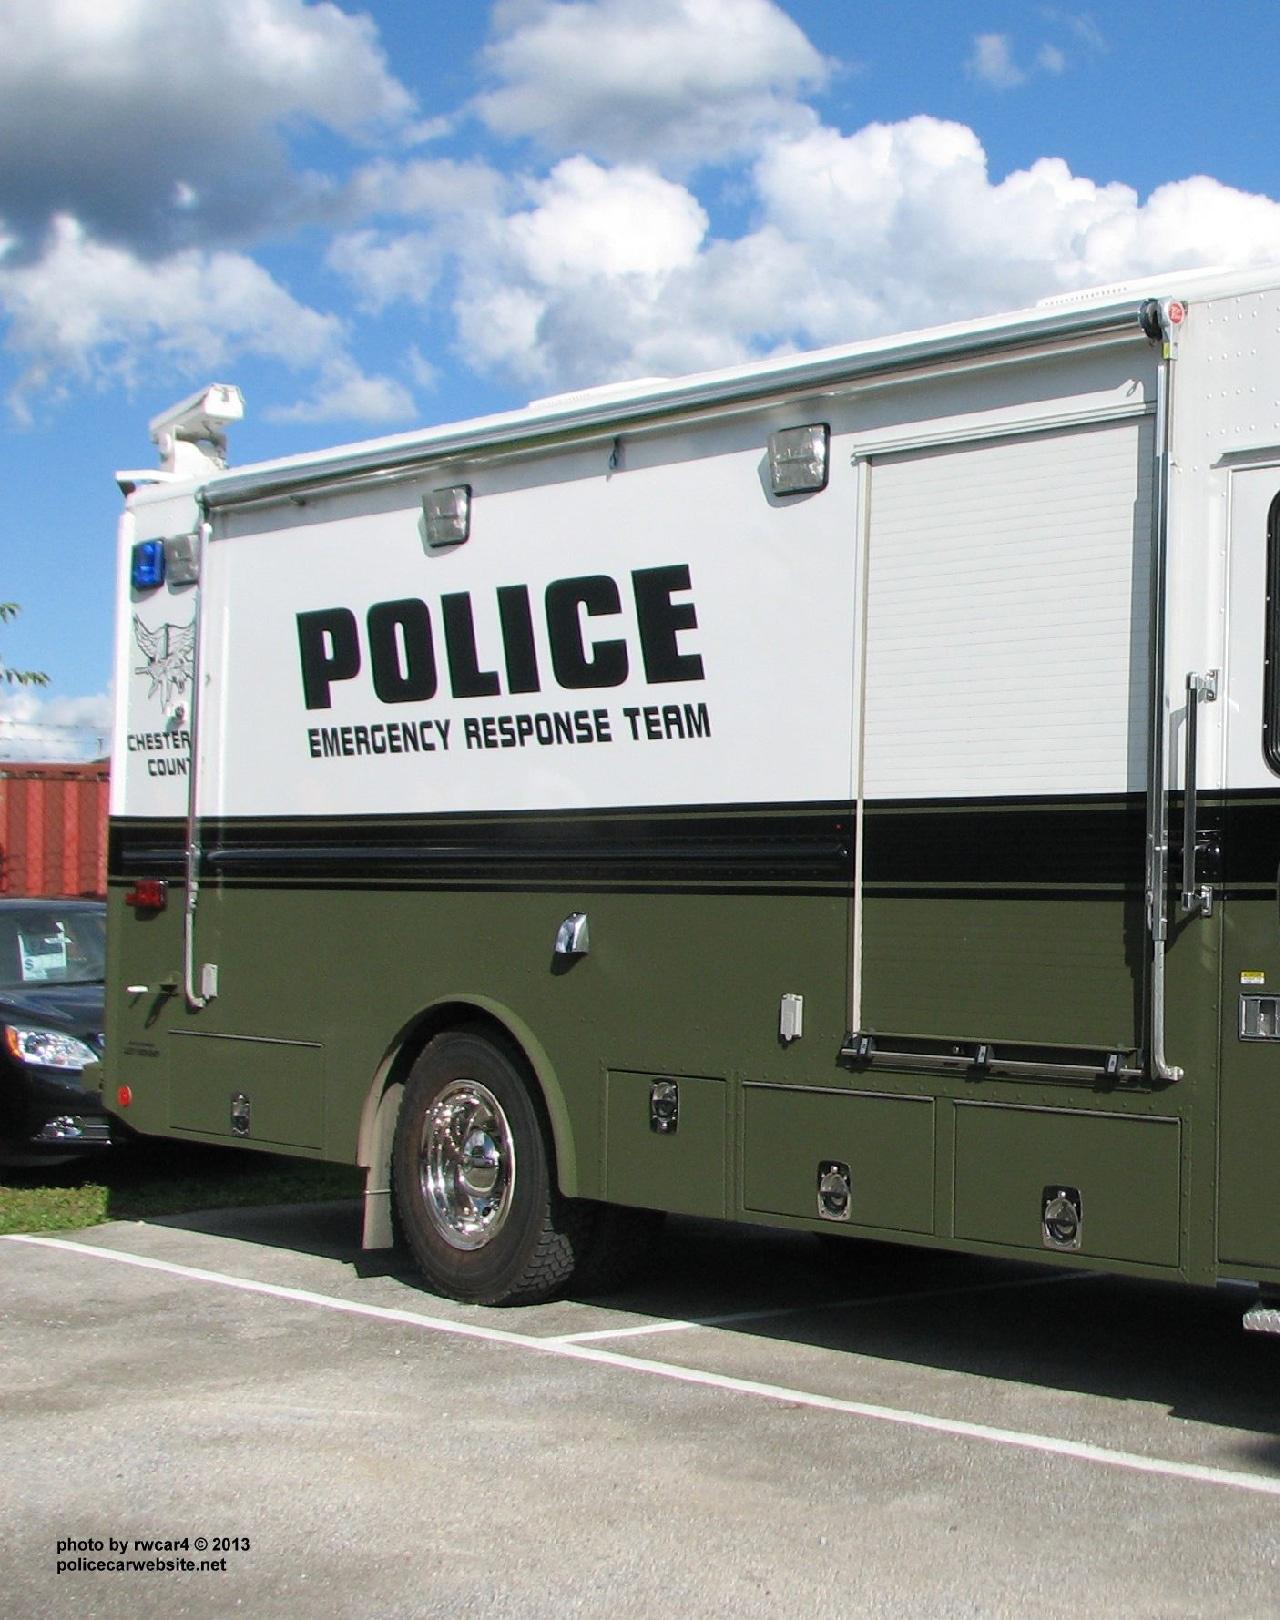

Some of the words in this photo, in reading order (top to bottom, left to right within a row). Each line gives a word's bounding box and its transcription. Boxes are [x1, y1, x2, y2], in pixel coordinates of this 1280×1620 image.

[296, 564, 706, 710] POLICE
[127, 730, 191, 751] CHESTER
[307, 719, 451, 758] EMERGENCY
[464, 708, 613, 749] RESPONSE
[623, 702, 712, 741] TEAM
